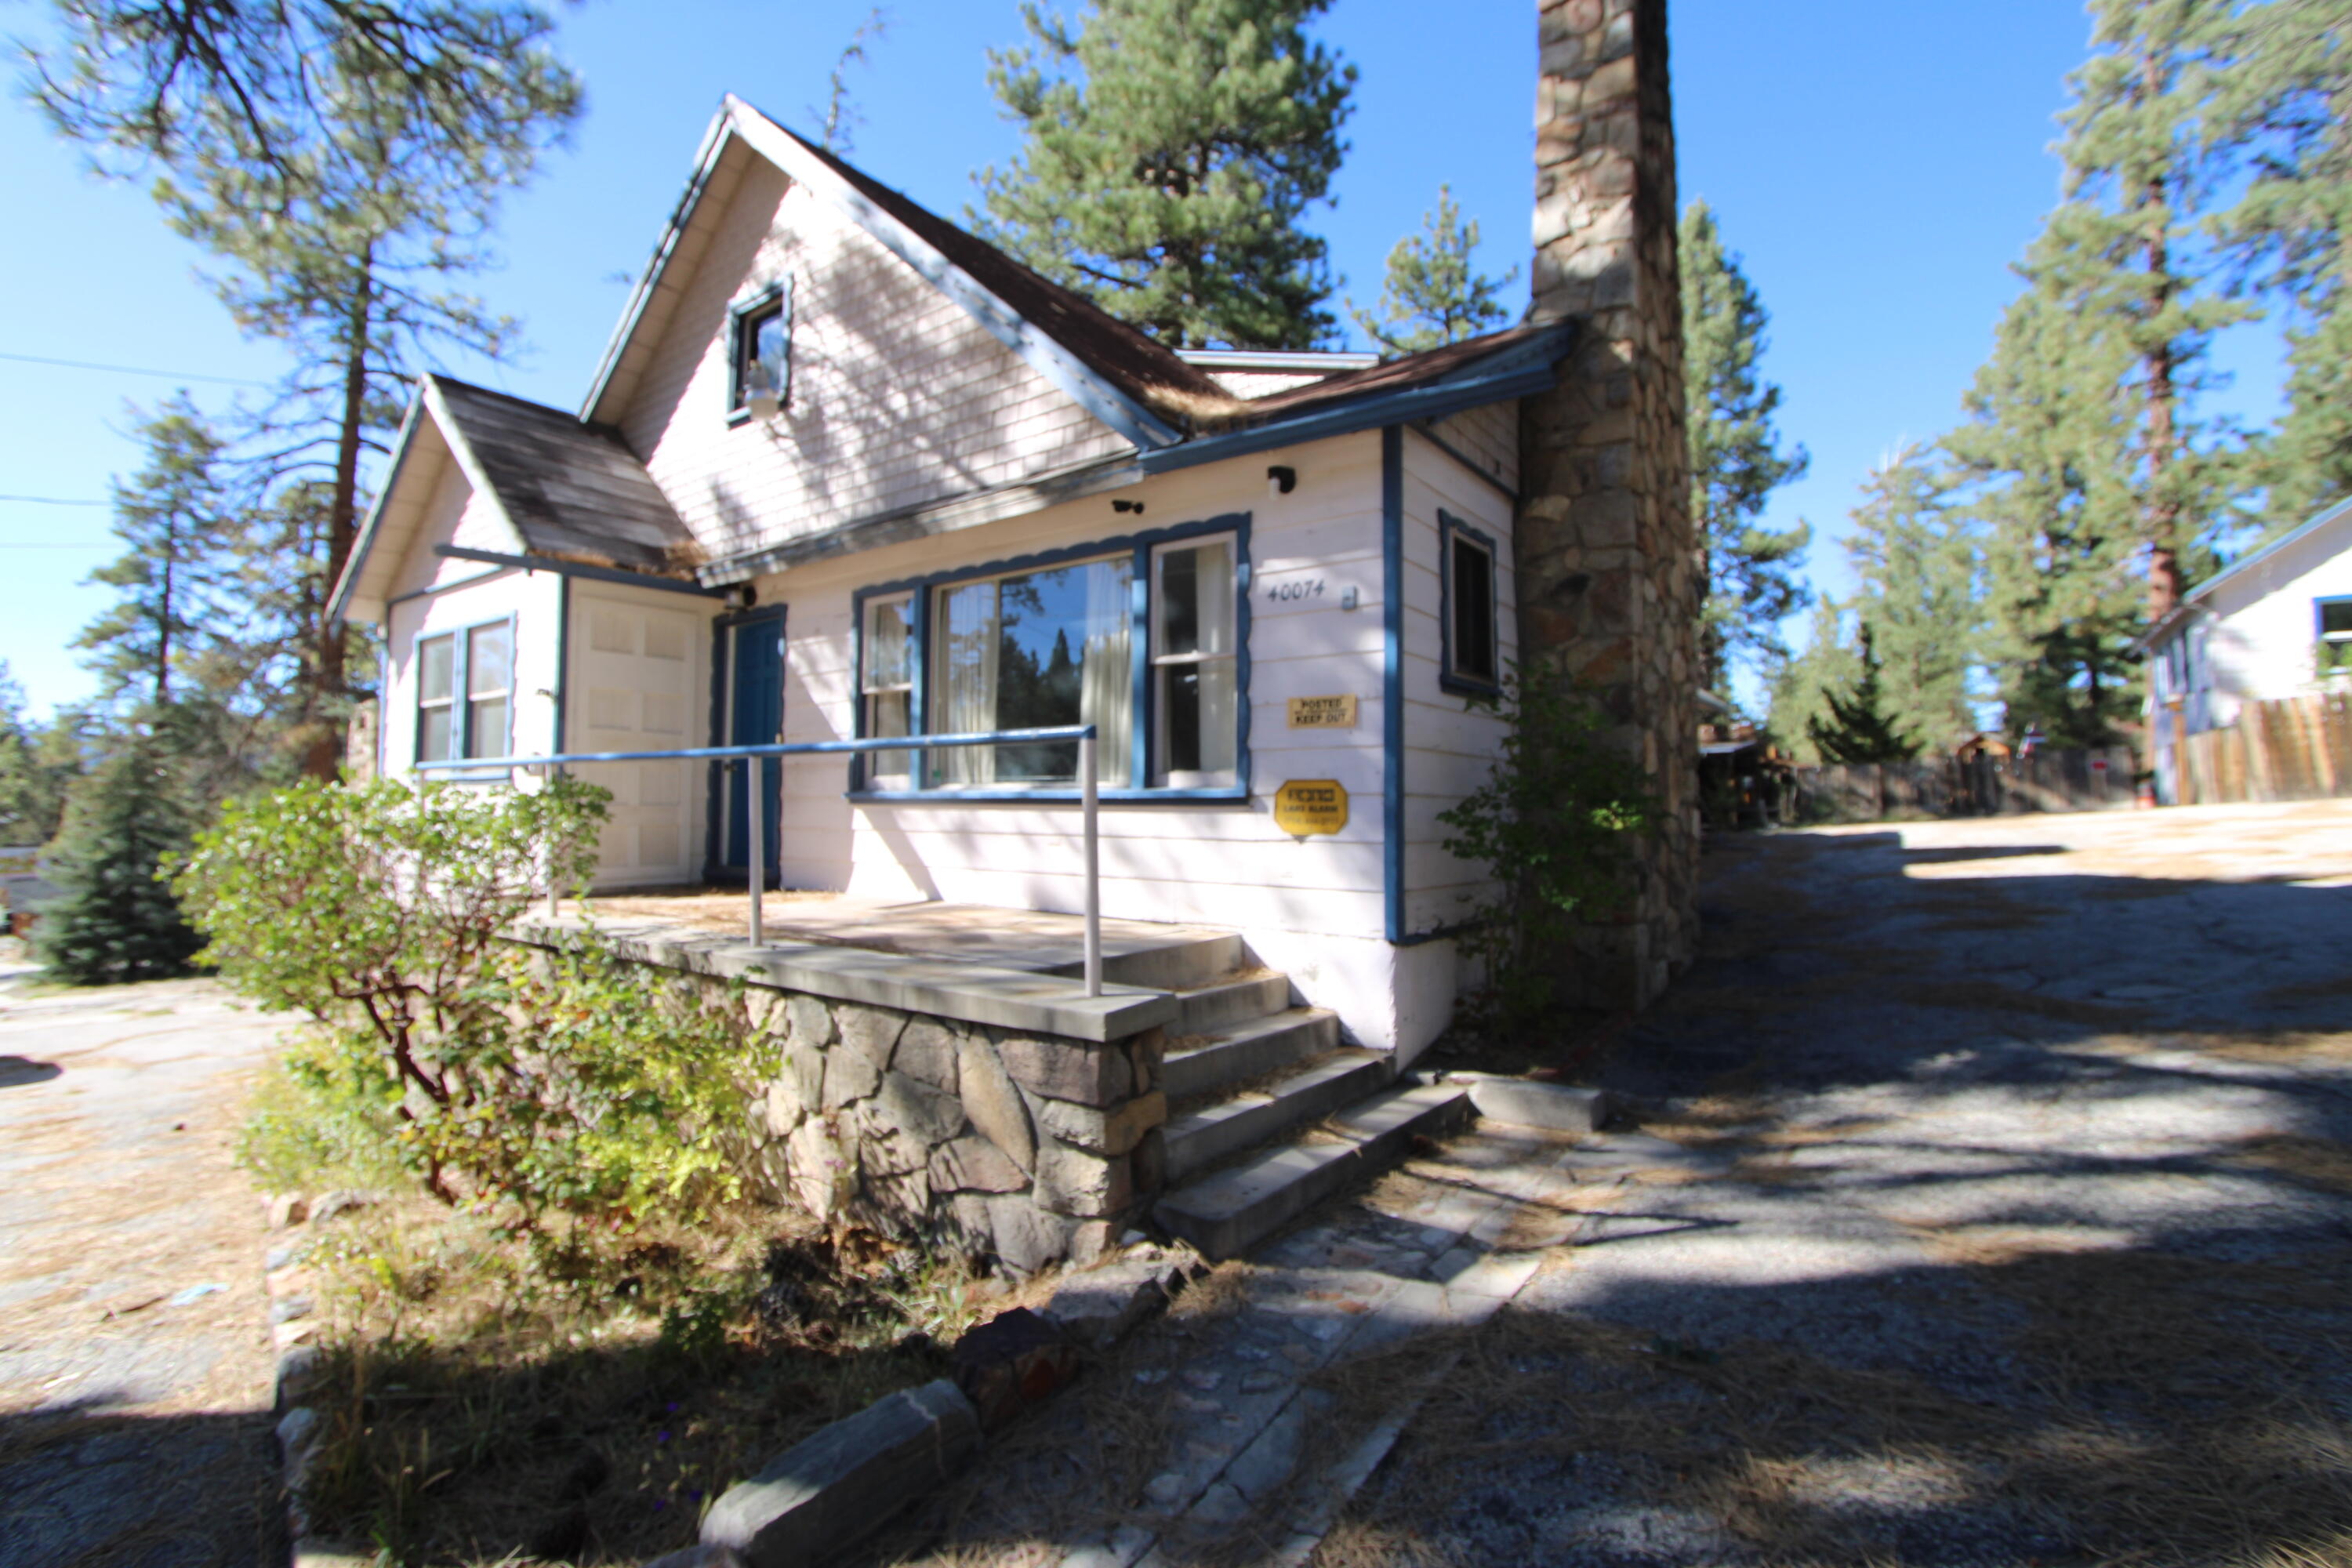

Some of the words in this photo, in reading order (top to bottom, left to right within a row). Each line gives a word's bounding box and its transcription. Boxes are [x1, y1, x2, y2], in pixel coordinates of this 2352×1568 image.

[1268, 579, 1326, 602] 40074
[1300, 698, 1343, 709] POSTED
[1296, 714, 1322, 724] KEEP
[1327, 713, 1347, 723] OUT
